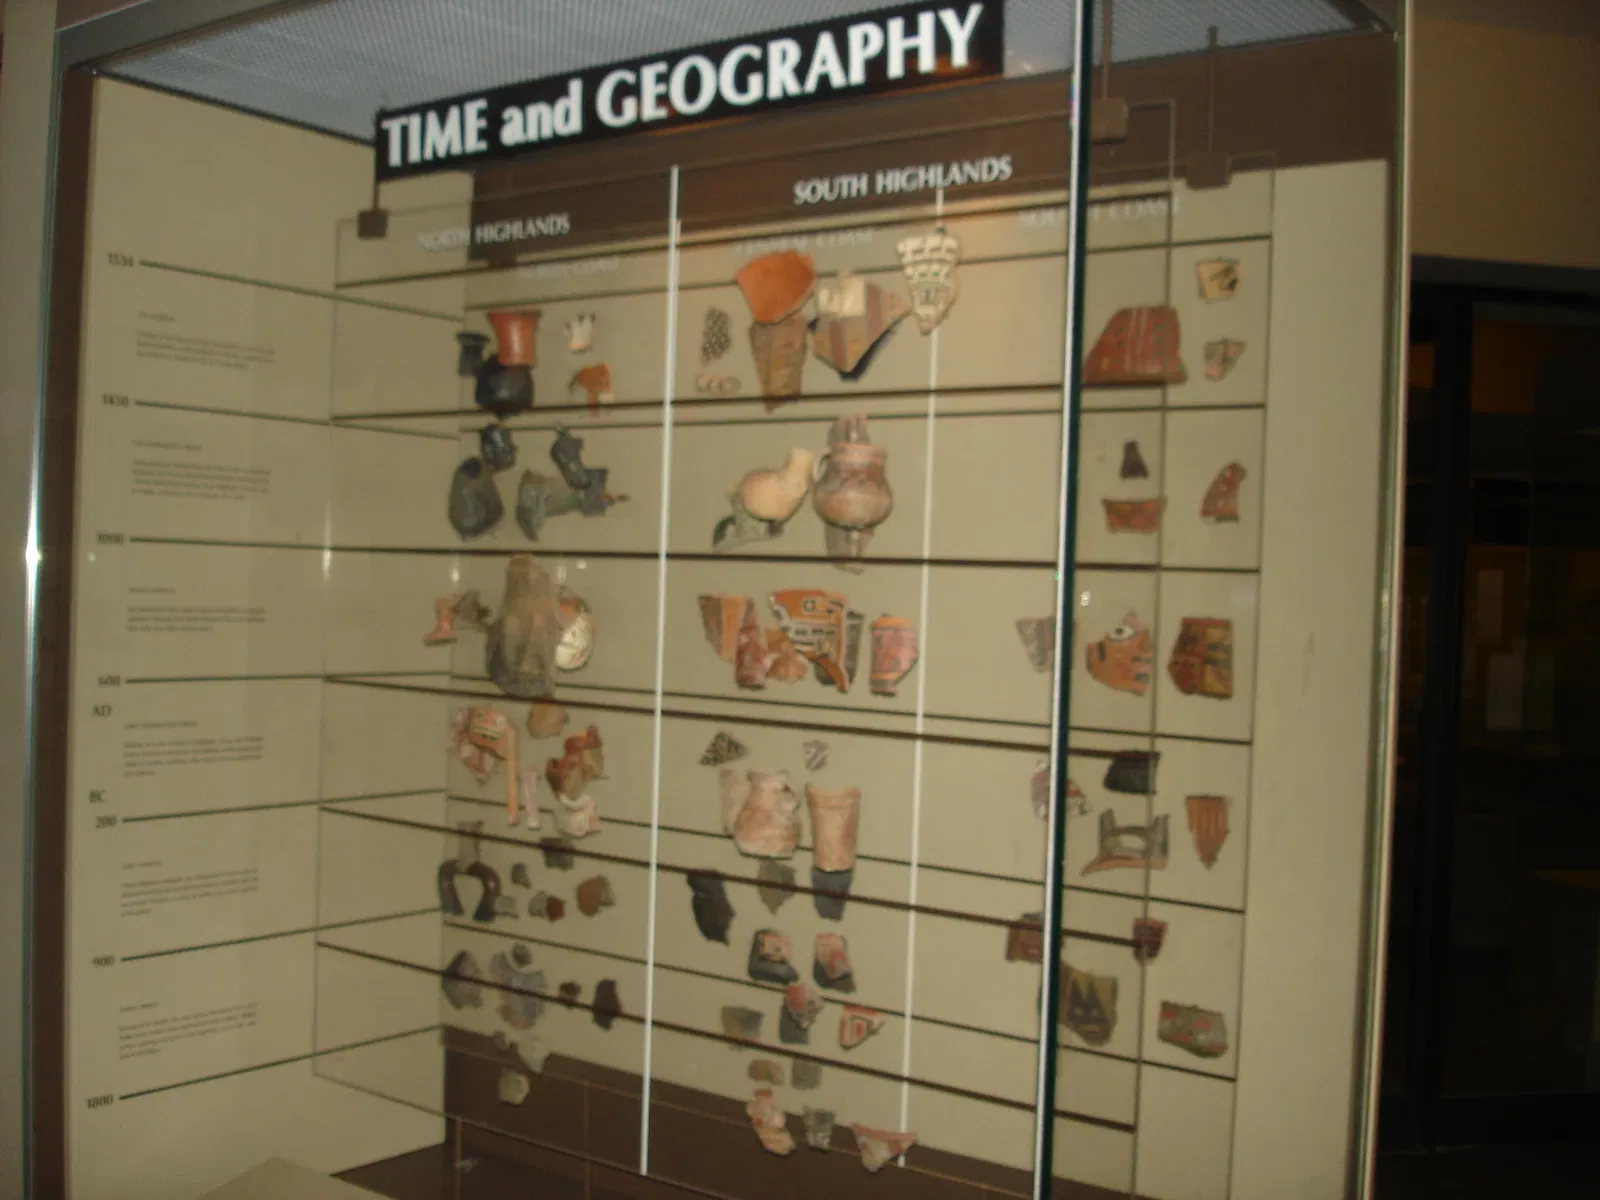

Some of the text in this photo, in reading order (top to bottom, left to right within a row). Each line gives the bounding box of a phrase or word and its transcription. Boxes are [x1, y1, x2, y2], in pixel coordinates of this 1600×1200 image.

[381, 2, 984, 168] TIME and GEOGRAPHY
[793, 154, 1013, 205] SOUTH HIGHLANDS
[474, 212, 571, 245] HIGHLANDS
